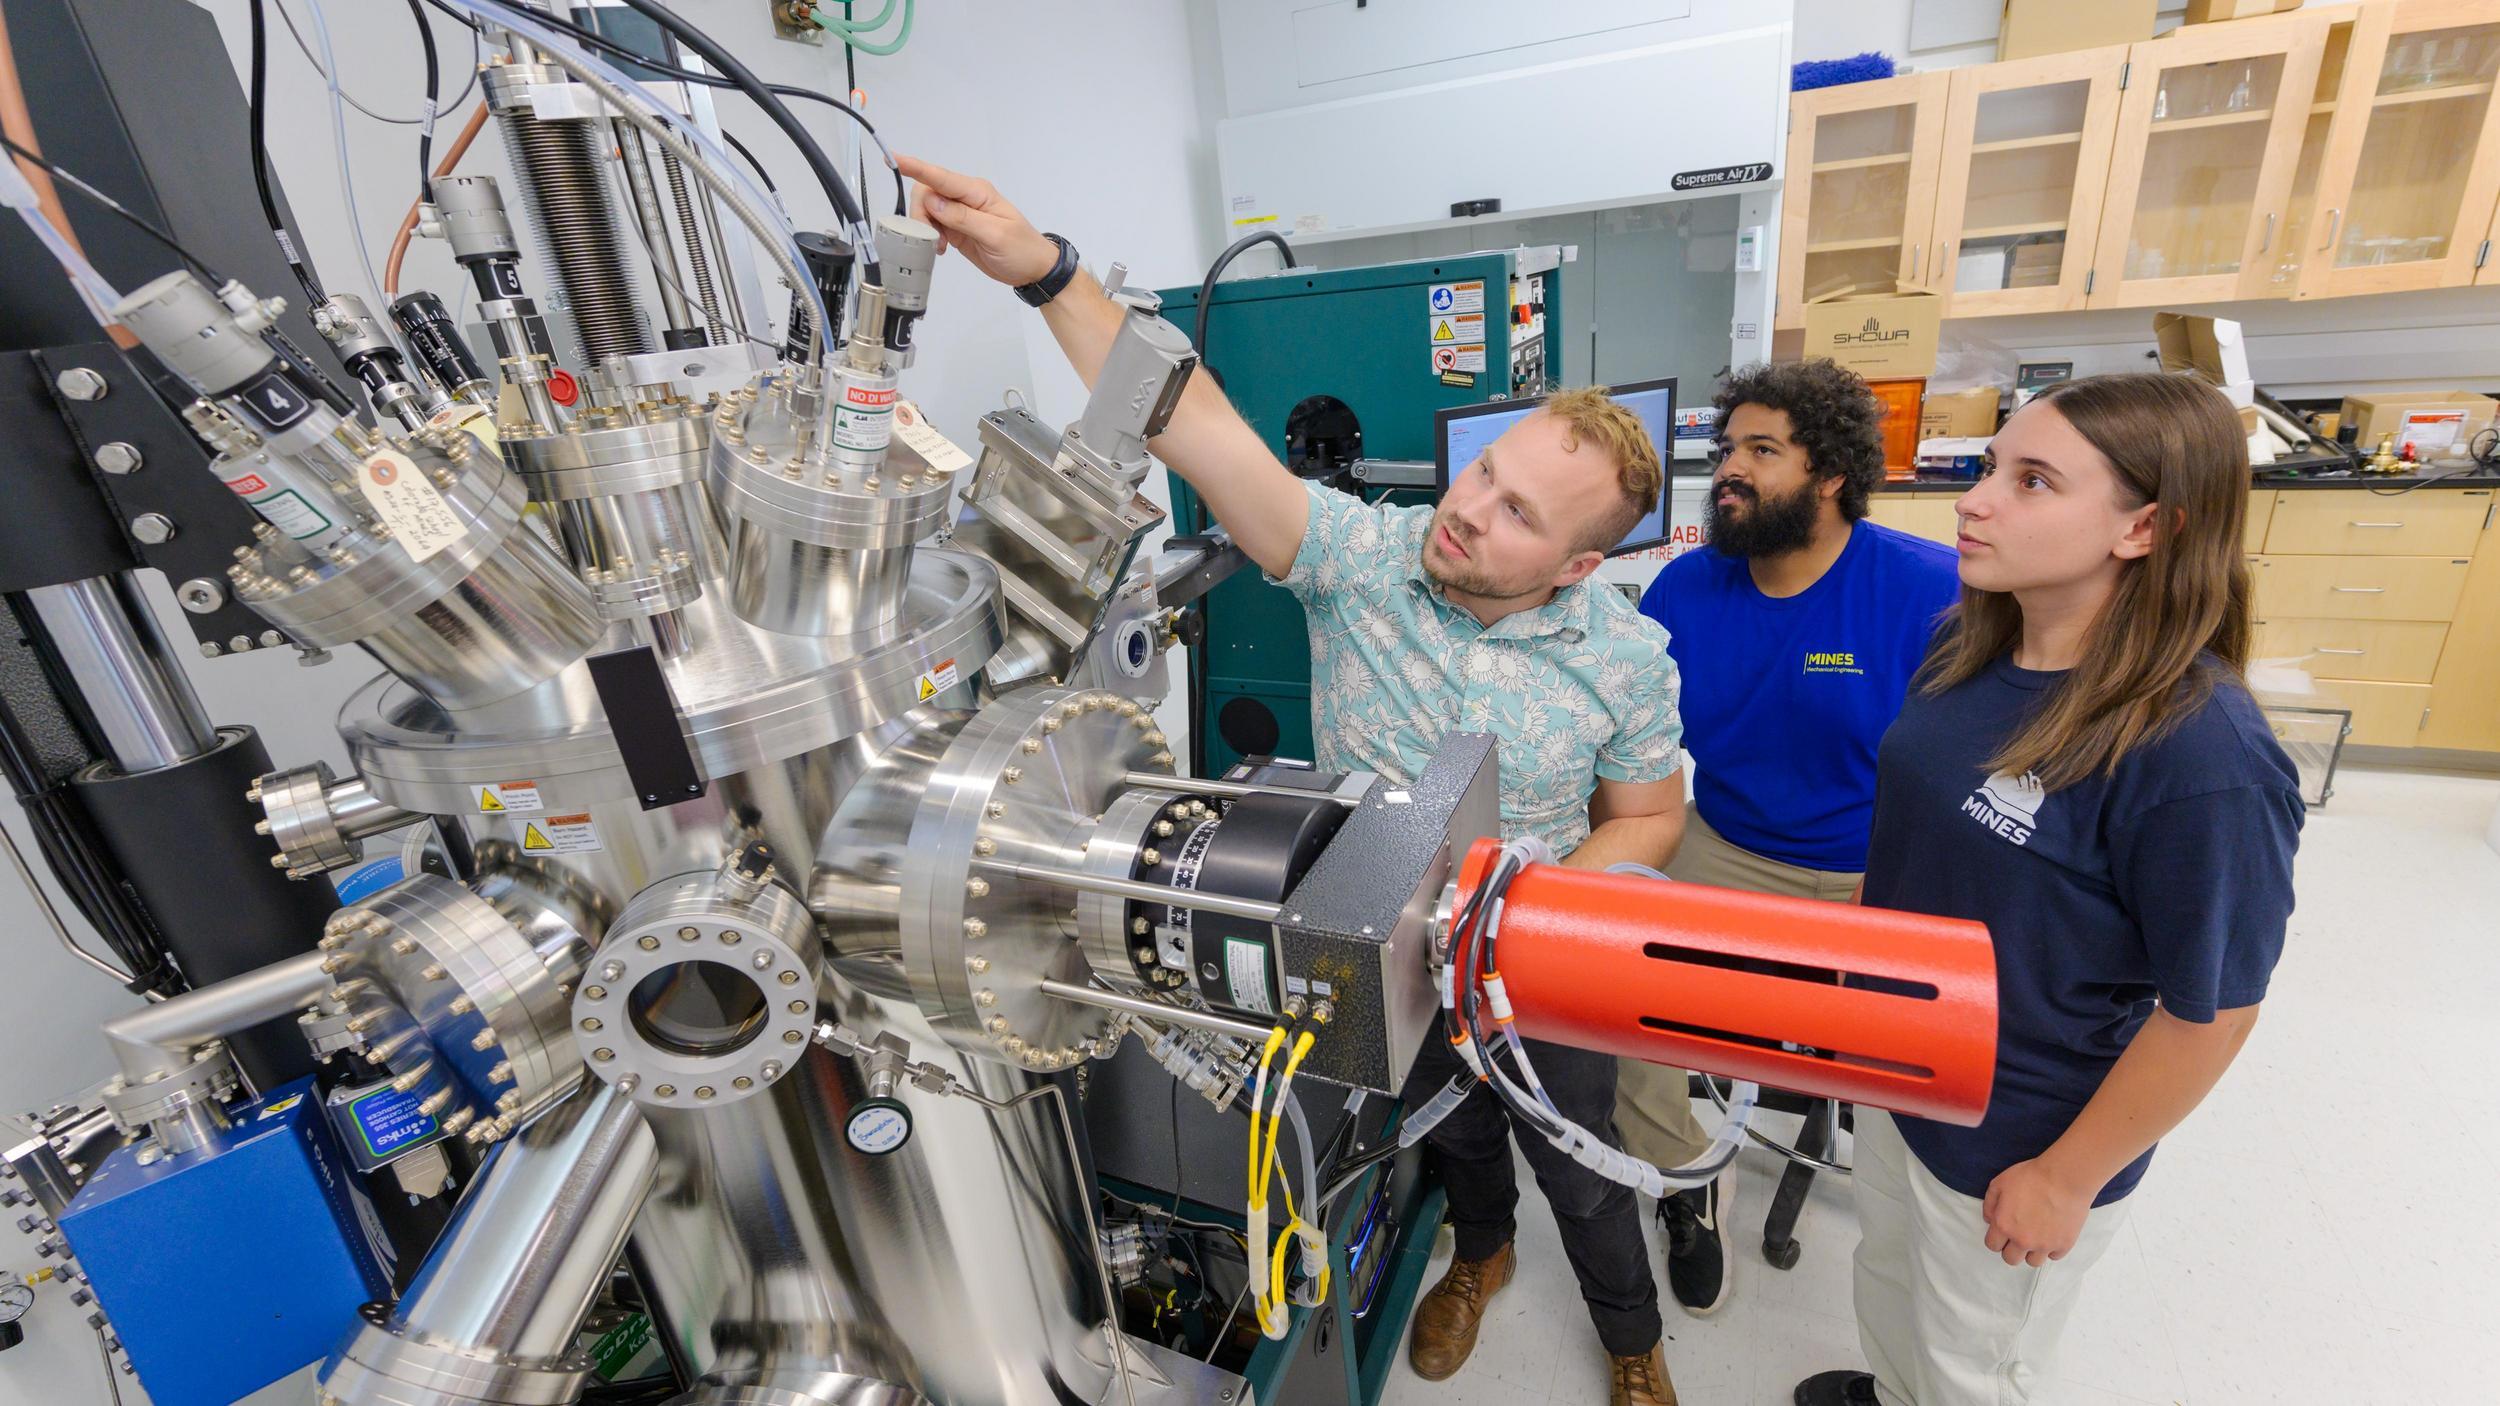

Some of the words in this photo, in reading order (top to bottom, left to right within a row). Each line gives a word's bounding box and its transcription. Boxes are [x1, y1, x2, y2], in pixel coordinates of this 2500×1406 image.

[1676, 172, 1725, 187] Supreme
[506, 269, 518, 289] 5
[1833, 329, 1910, 344] SHOWA
[364, 372, 376, 387] 1
[266, 388, 291, 410] 4
[850, 390, 866, 402] NO
[868, 392, 879, 402] DI
[880, 390, 896, 403] WAT
[1677, 412, 1688, 423] ut
[1672, 526, 1707, 543] ABL
[1649, 546, 1674, 560] FIRE
[1808, 653, 1854, 666] MINES
[1834, 667, 1864, 675] Engineering
[1961, 795, 2032, 846] MINES
[365, 1096, 415, 1121] TRANSDUCER
[368, 1108, 402, 1127] CATHODE
[376, 1124, 412, 1148] mks
